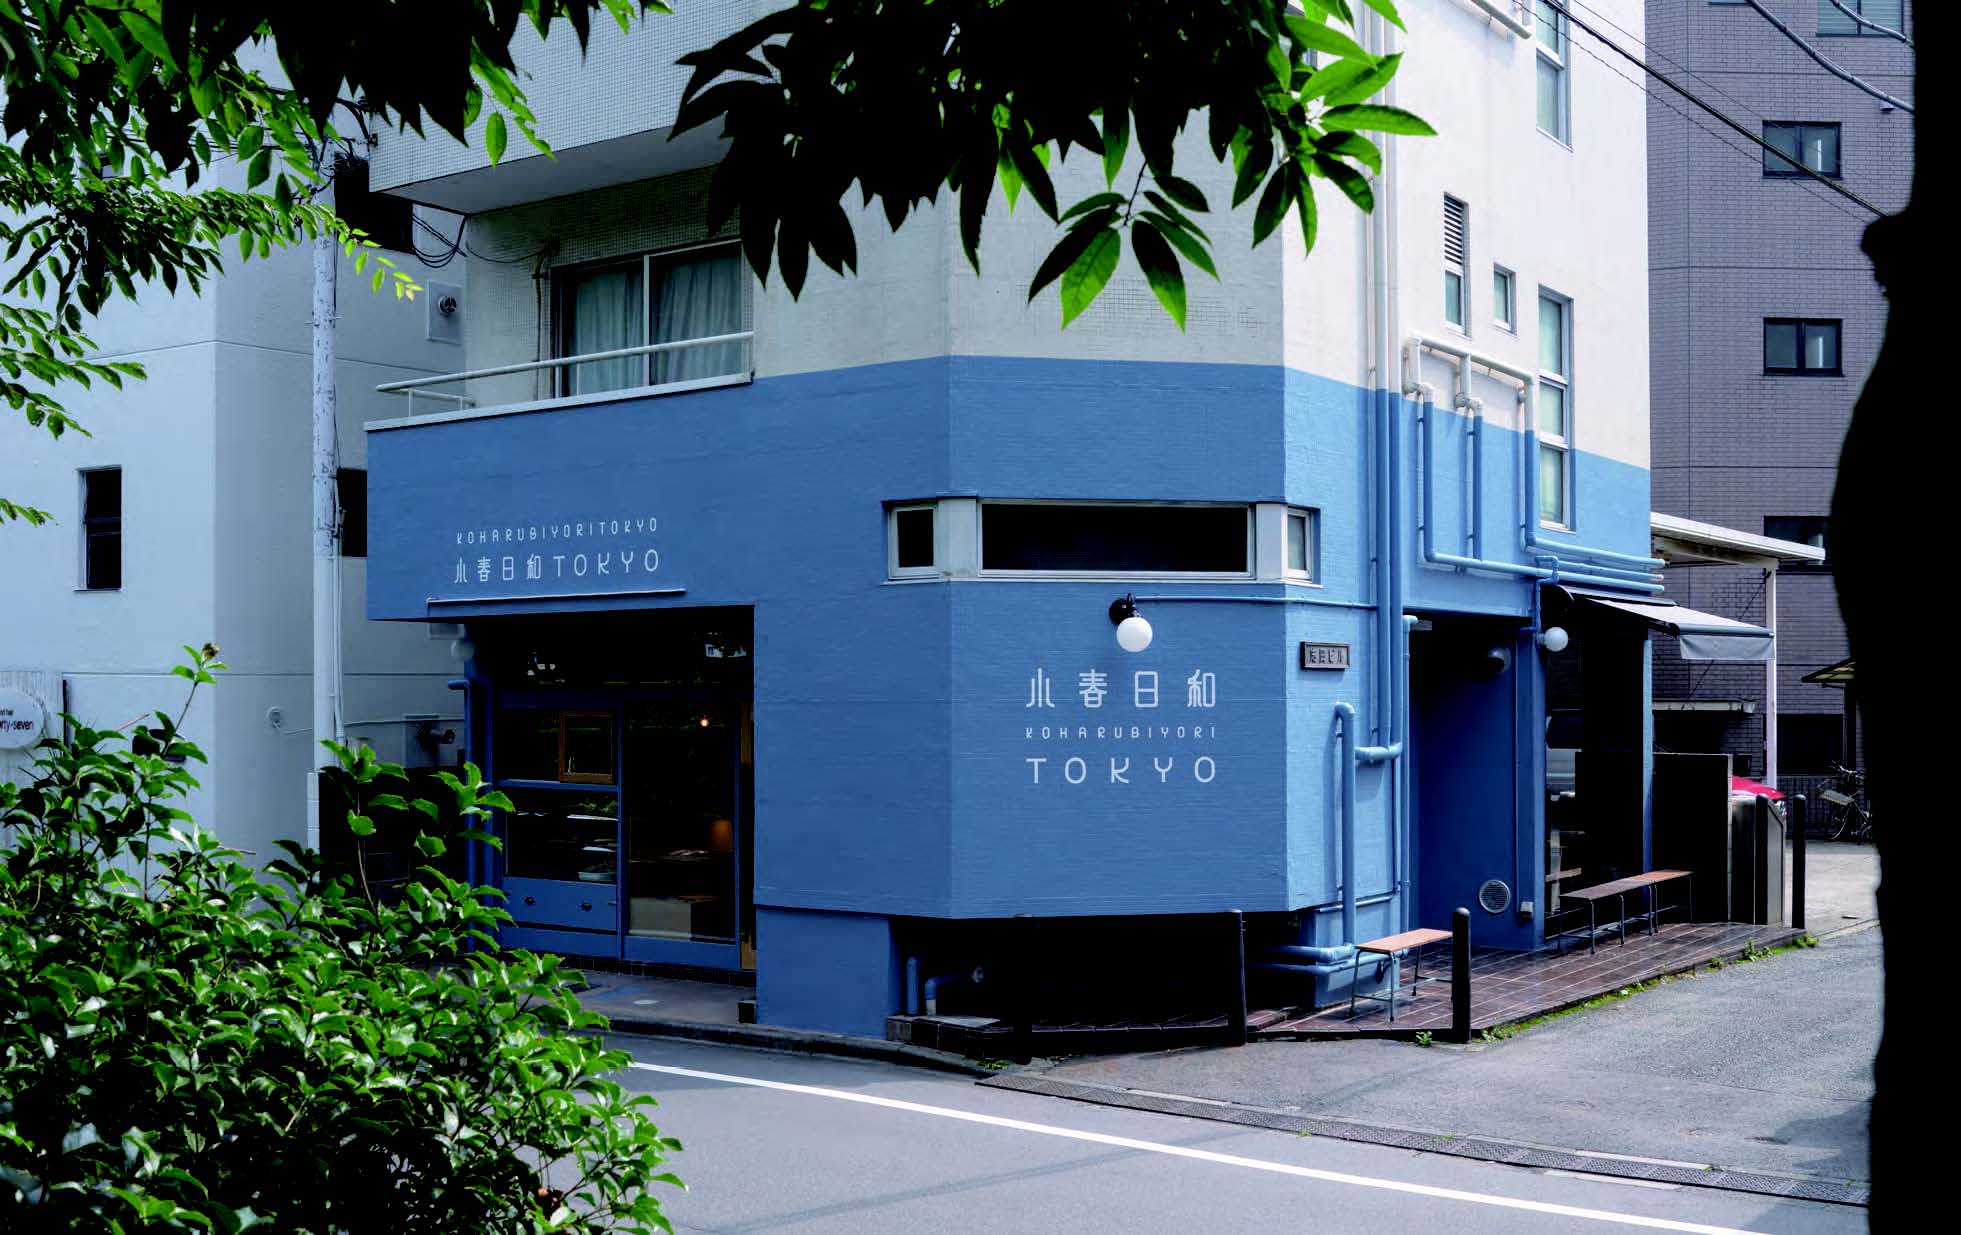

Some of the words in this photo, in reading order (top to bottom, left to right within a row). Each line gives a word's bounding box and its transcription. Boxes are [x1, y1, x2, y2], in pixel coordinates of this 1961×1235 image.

[1025, 667, 1217, 708] 小春日和
[1025, 726, 1215, 740] KOHARUBIYORI
[1025, 756, 1217, 784] TOKYO
